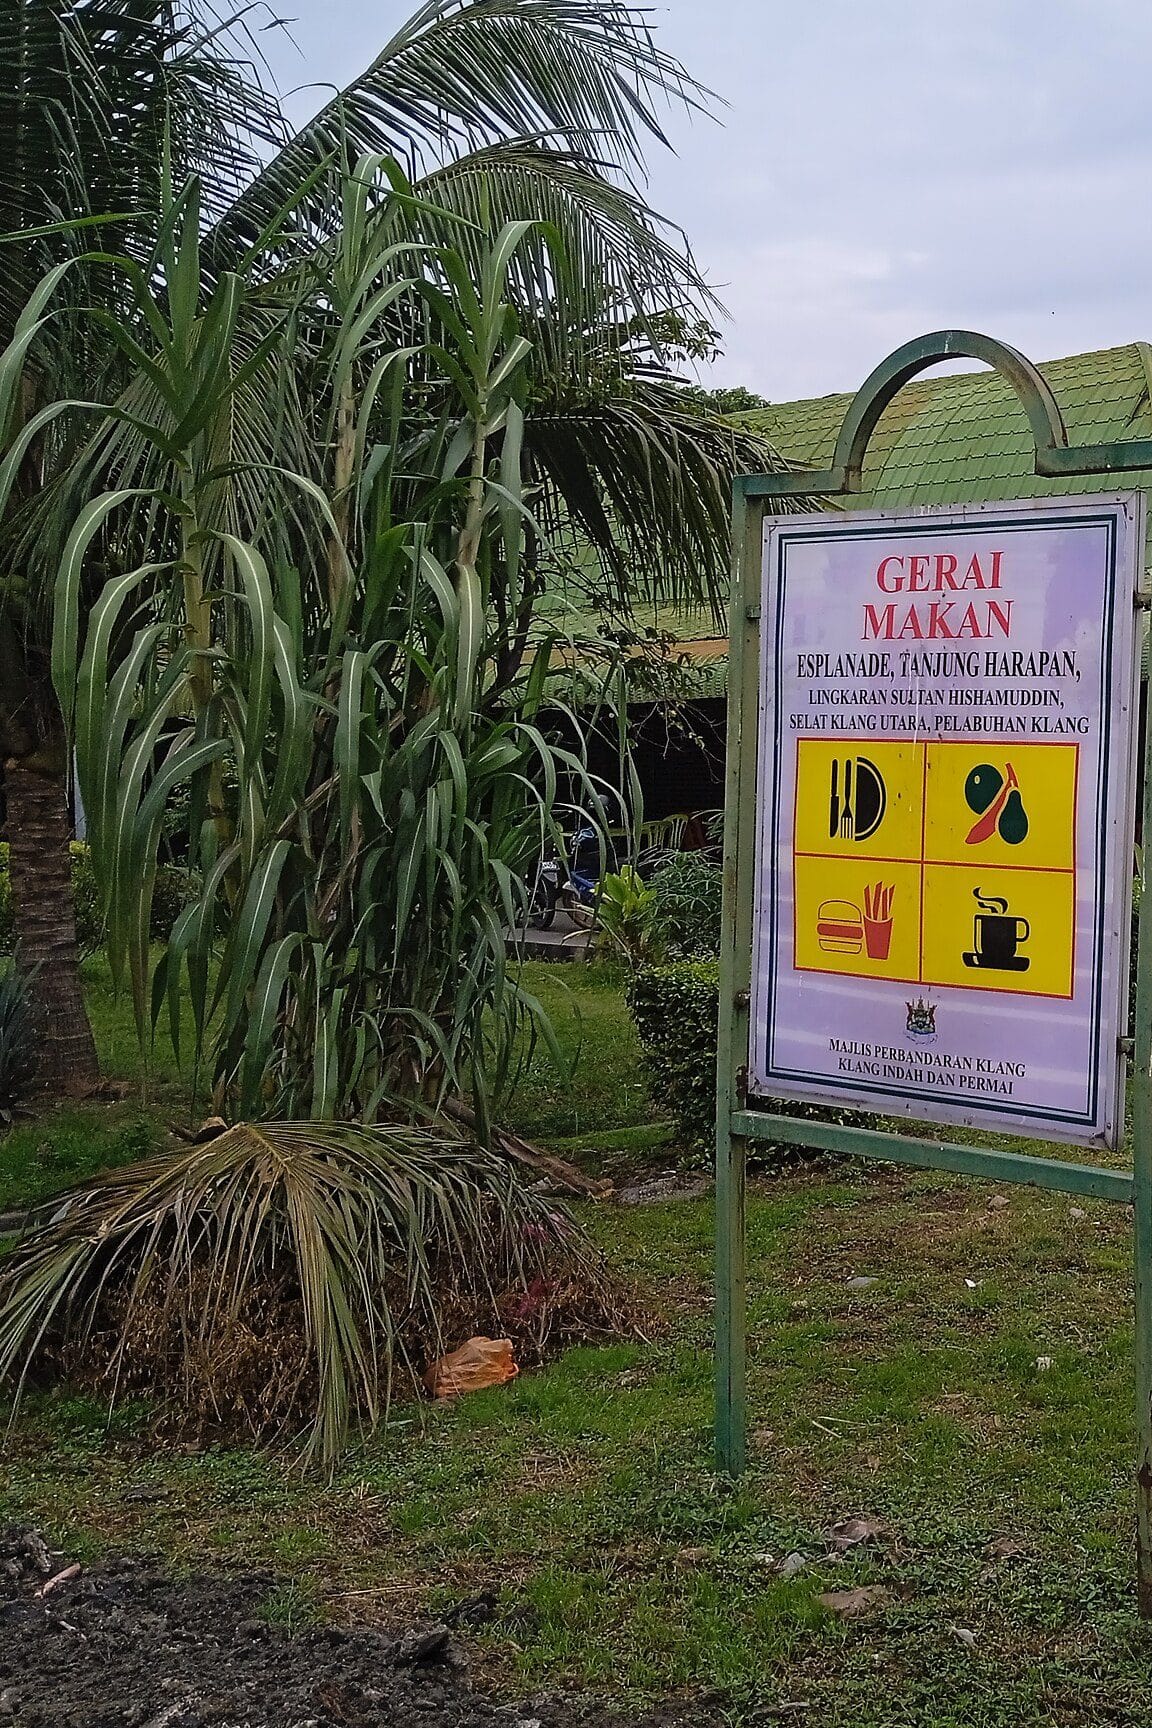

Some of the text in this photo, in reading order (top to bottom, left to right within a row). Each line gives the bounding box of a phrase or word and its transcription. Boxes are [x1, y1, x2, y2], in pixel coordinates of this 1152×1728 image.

[877, 551, 1004, 593] GERAI
[861, 600, 1014, 640] MAKAN
[797, 650, 1081, 681] ESPLANADE, TANJUNG HARAPAN,
[809, 689, 1065, 709] LINGKARAN SULTAN HISHAMUDDIN,
[790, 714, 1089, 734] SELAT KLANG UTARA, PELABUHAN KLANG
[829, 1038, 1026, 1077] MAJLIS PERBANDARAN KLANG
[838, 1058, 1013, 1095] KLANG INDAH DAN PERMAI
